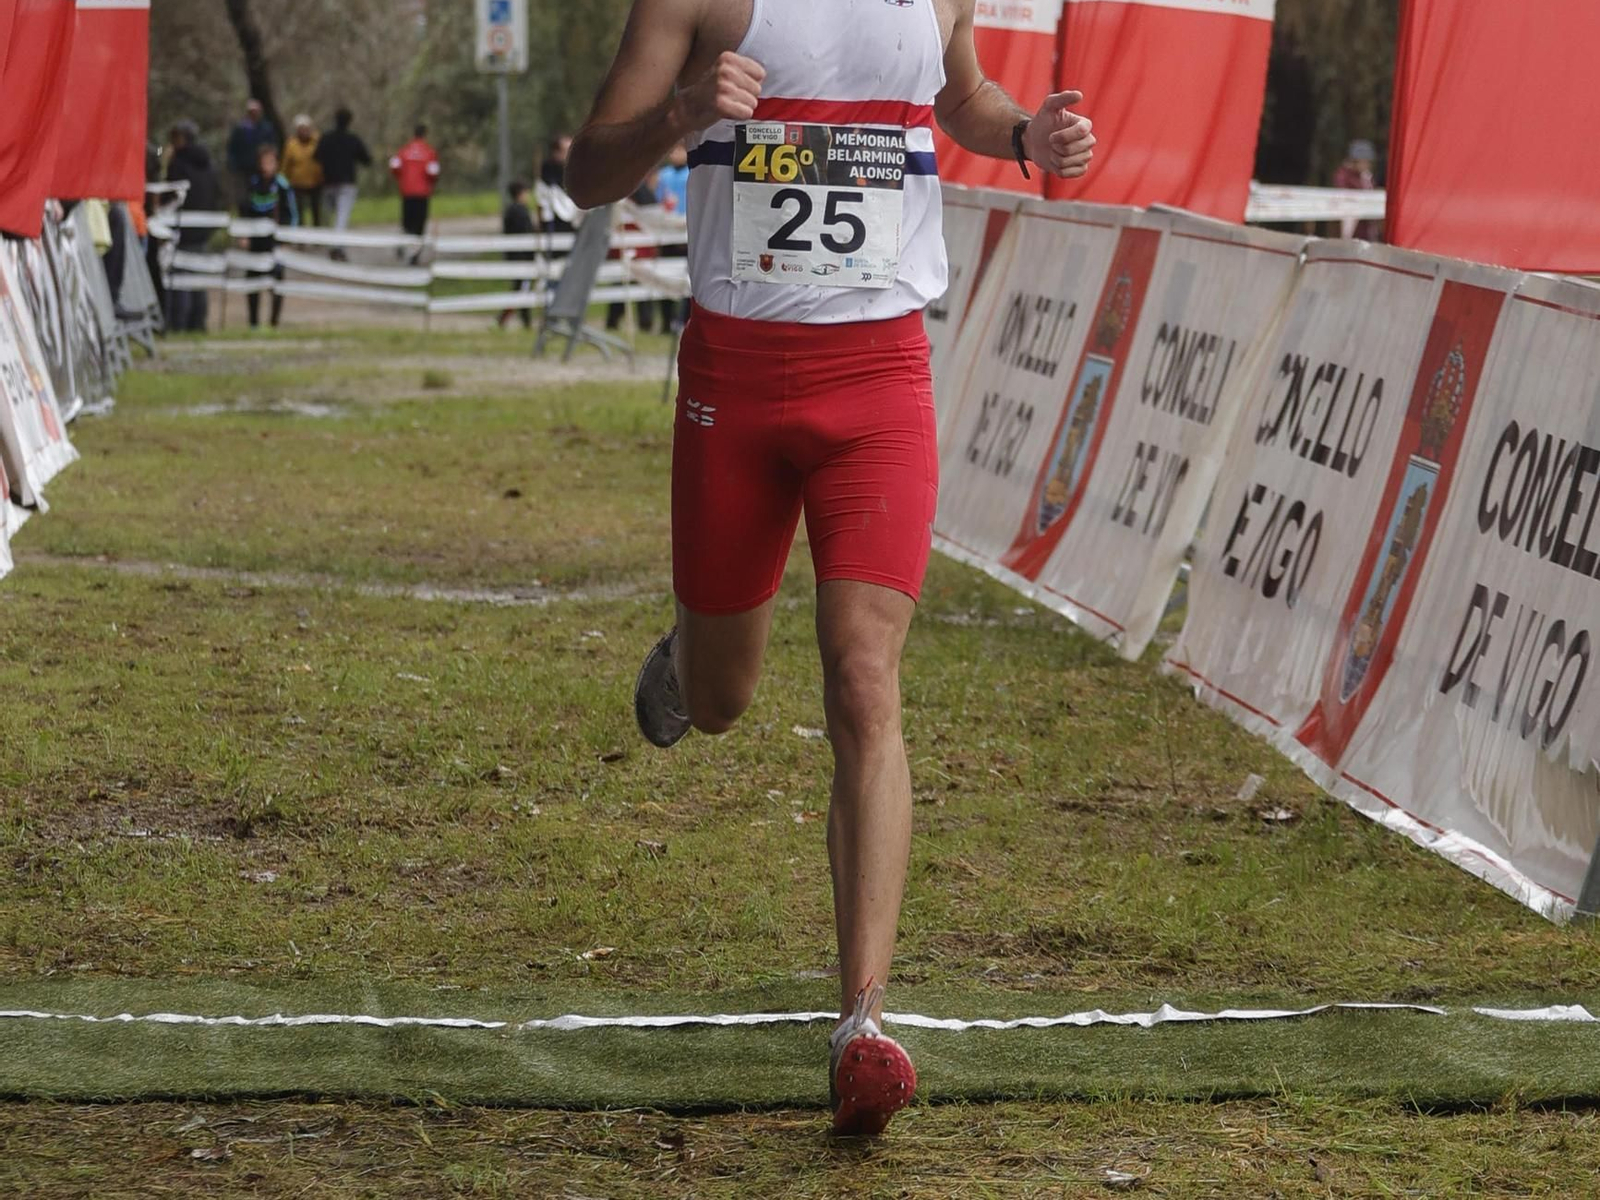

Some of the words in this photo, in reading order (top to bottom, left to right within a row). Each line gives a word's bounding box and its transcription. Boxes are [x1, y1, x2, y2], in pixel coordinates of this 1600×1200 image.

[748, 127, 782, 135] CONCELLO
[835, 132, 906, 149] MEMORIAL
[827, 149, 906, 165] BELARMINO
[849, 166, 902, 182] ALONSO
[767, 188, 866, 255] 25
[1477, 419, 1600, 581] CONCEL
[1438, 582, 1509, 710] DE
[1491, 603, 1590, 751] VIGO
